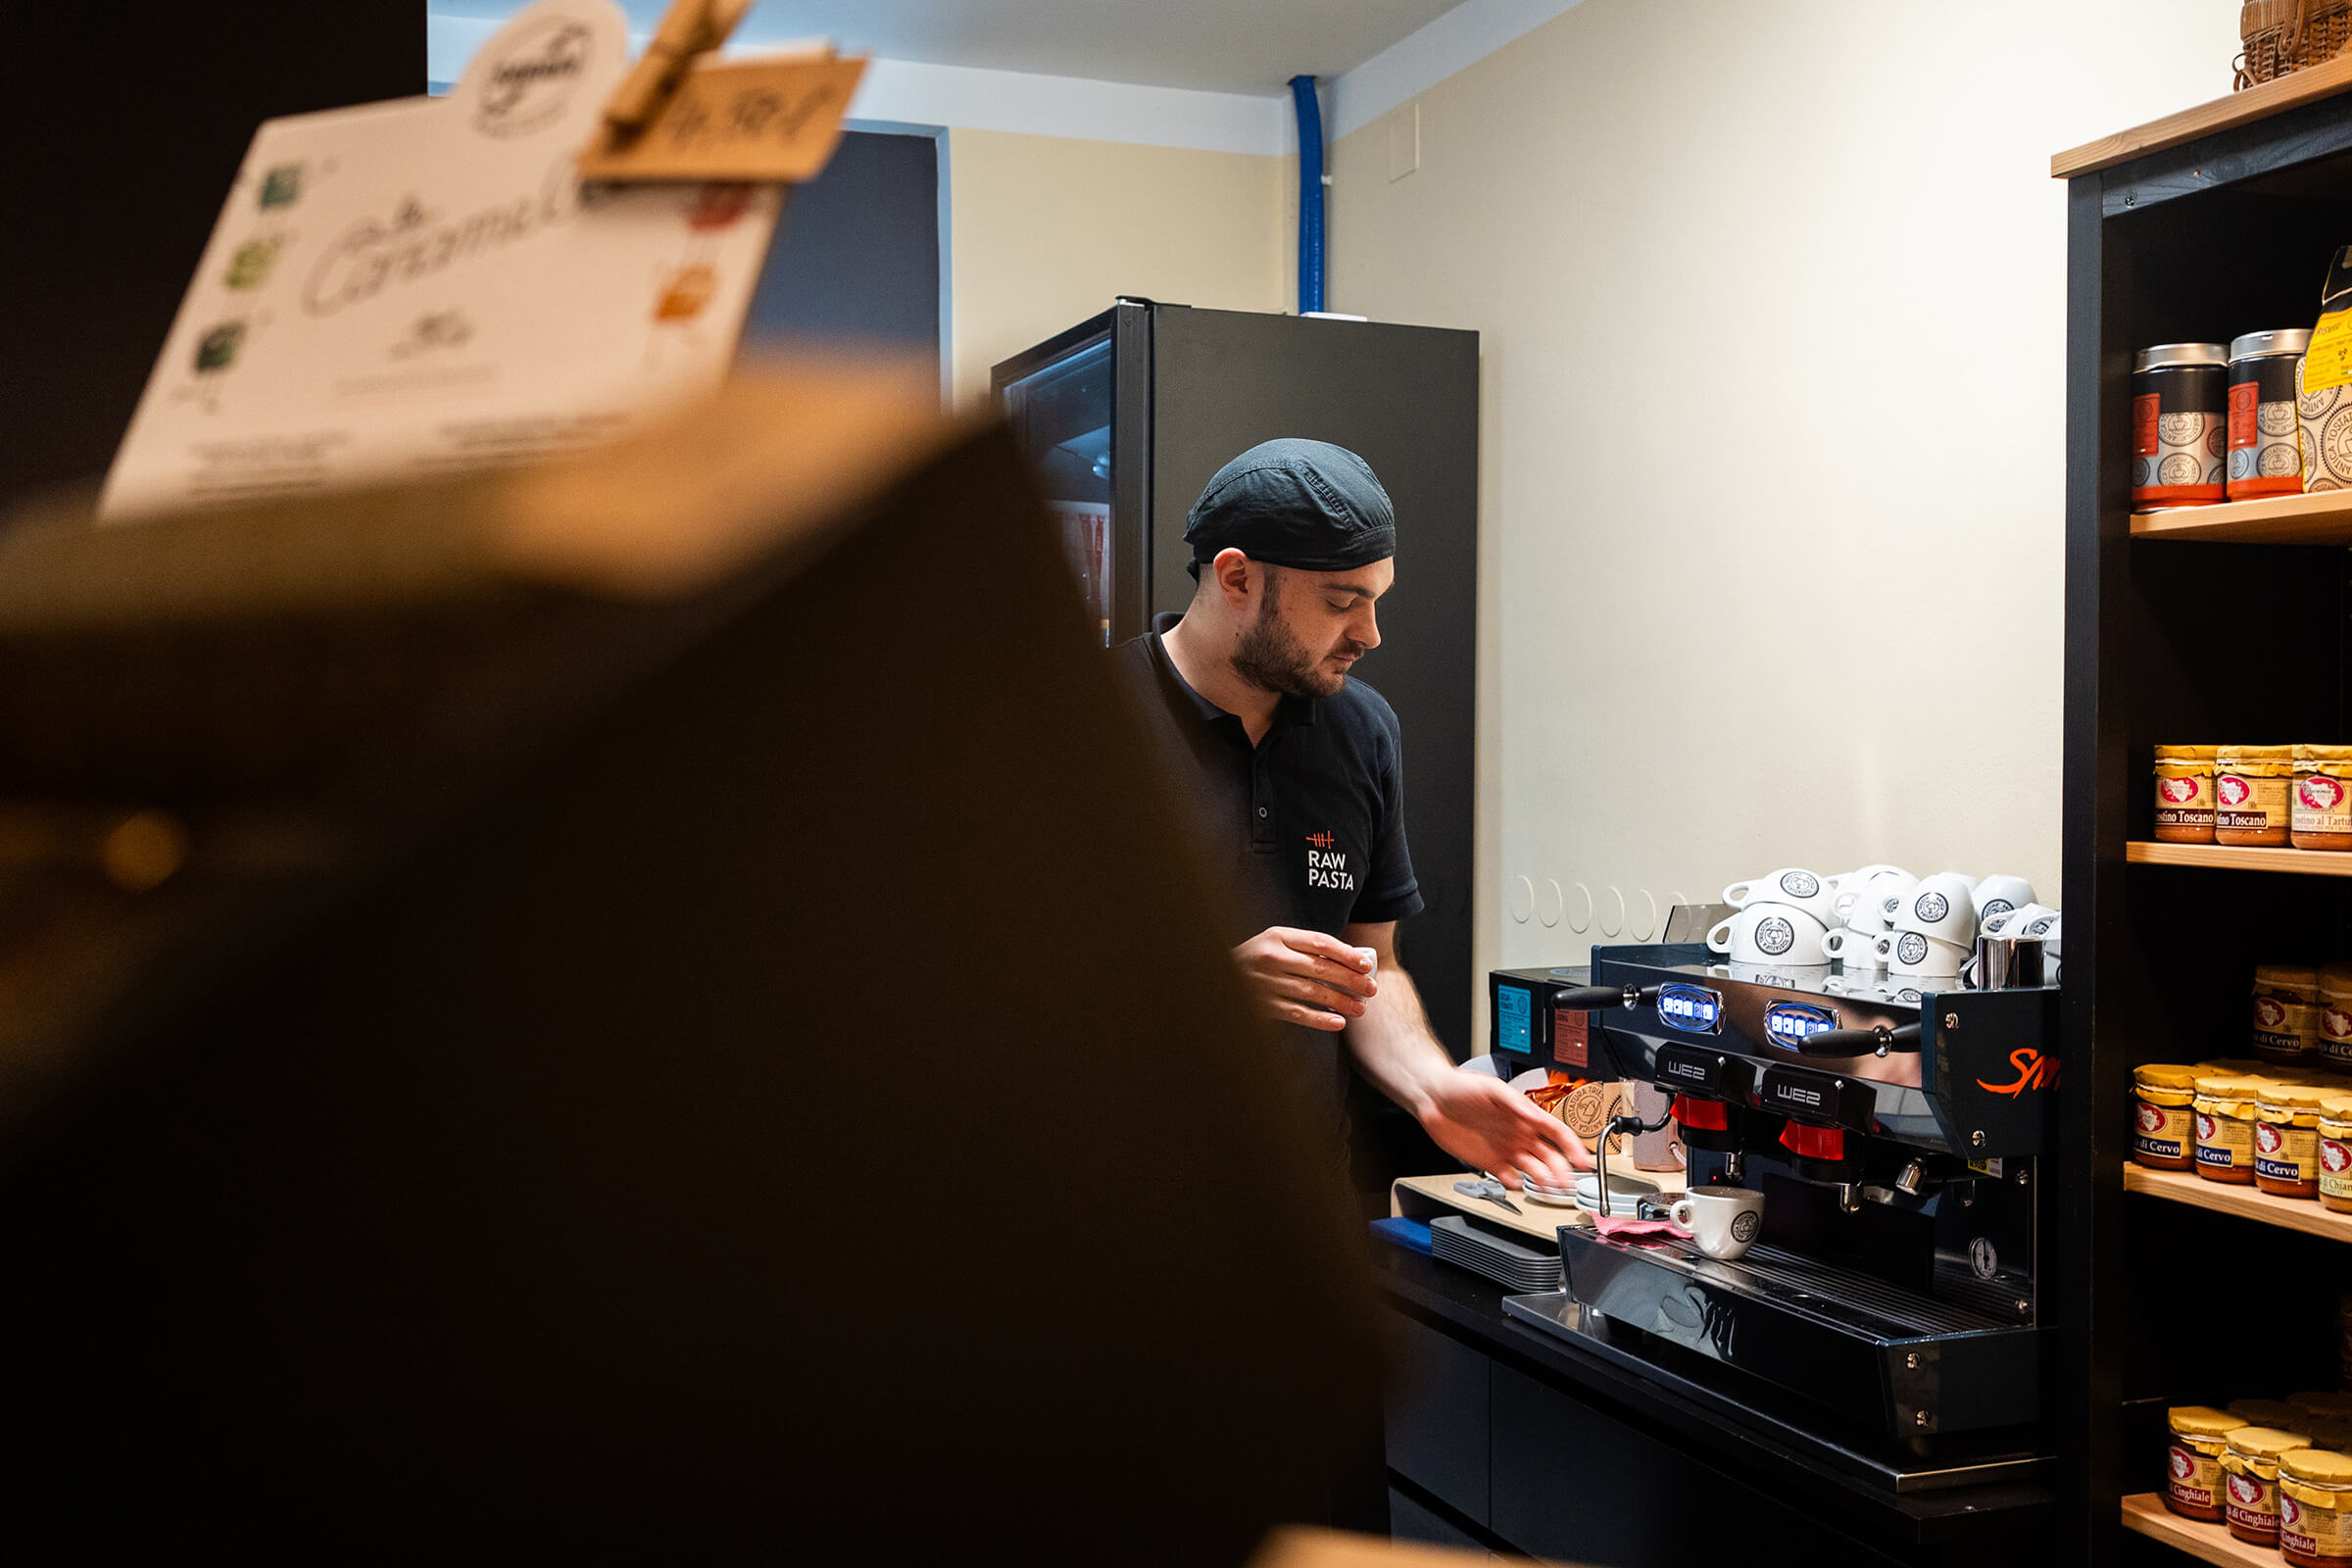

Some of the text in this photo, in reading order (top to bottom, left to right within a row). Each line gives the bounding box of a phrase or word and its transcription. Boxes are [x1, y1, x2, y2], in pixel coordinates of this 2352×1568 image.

[2178, 810, 2214, 823] Toscano
[2230, 813, 2266, 826] Toscano
[1308, 850, 1346, 871] RAW
[1308, 868, 1354, 891] PASTA
[2269, 1035, 2299, 1048] Cervo
[2149, 1140, 2180, 1153] Cervo
[2203, 1149, 2231, 1162] Cervo
[2267, 1162, 2299, 1177] Cervo
[2174, 1484, 2211, 1503] Cinghiale
